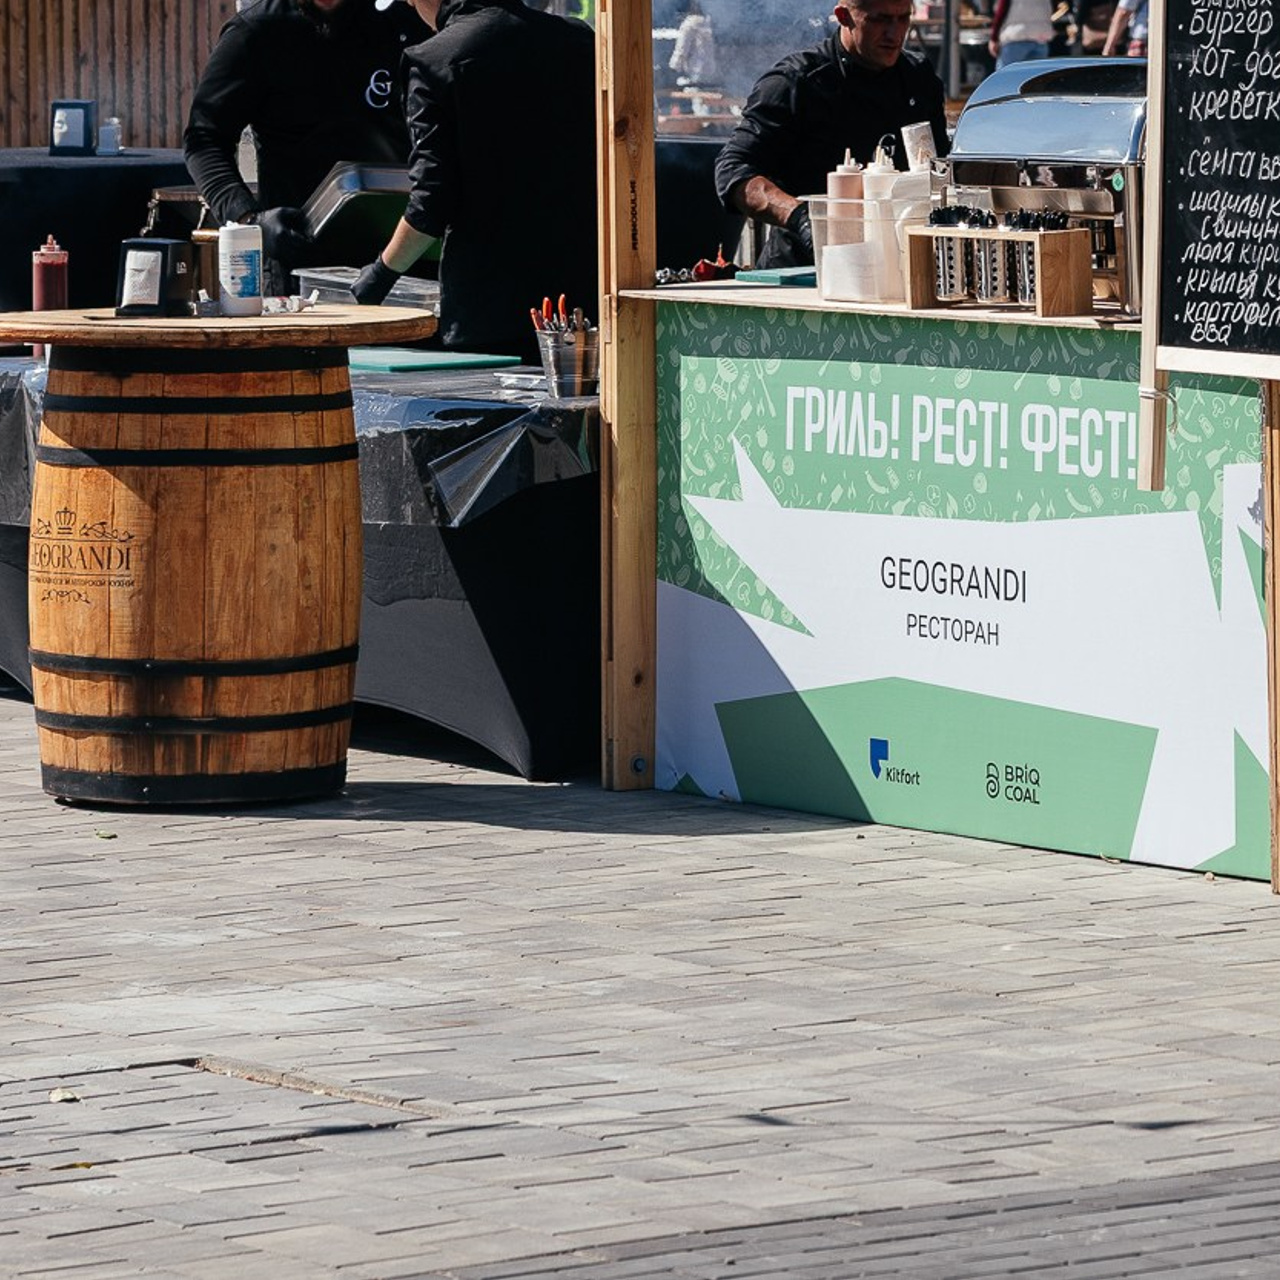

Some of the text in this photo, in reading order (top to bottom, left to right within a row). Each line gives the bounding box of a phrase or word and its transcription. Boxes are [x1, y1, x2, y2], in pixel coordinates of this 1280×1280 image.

[1189, 8, 1274, 49] Бургер
[785, 385, 1136, 480] ГРИЛЬ! РЕСТ! ФЕСТ!
[881, 556, 1026, 604] GEOGRANDI
[906, 613, 999, 646] РЕСТОРАН
[886, 767, 920, 786] Kitfort
[1004, 784, 1041, 804] COAL
